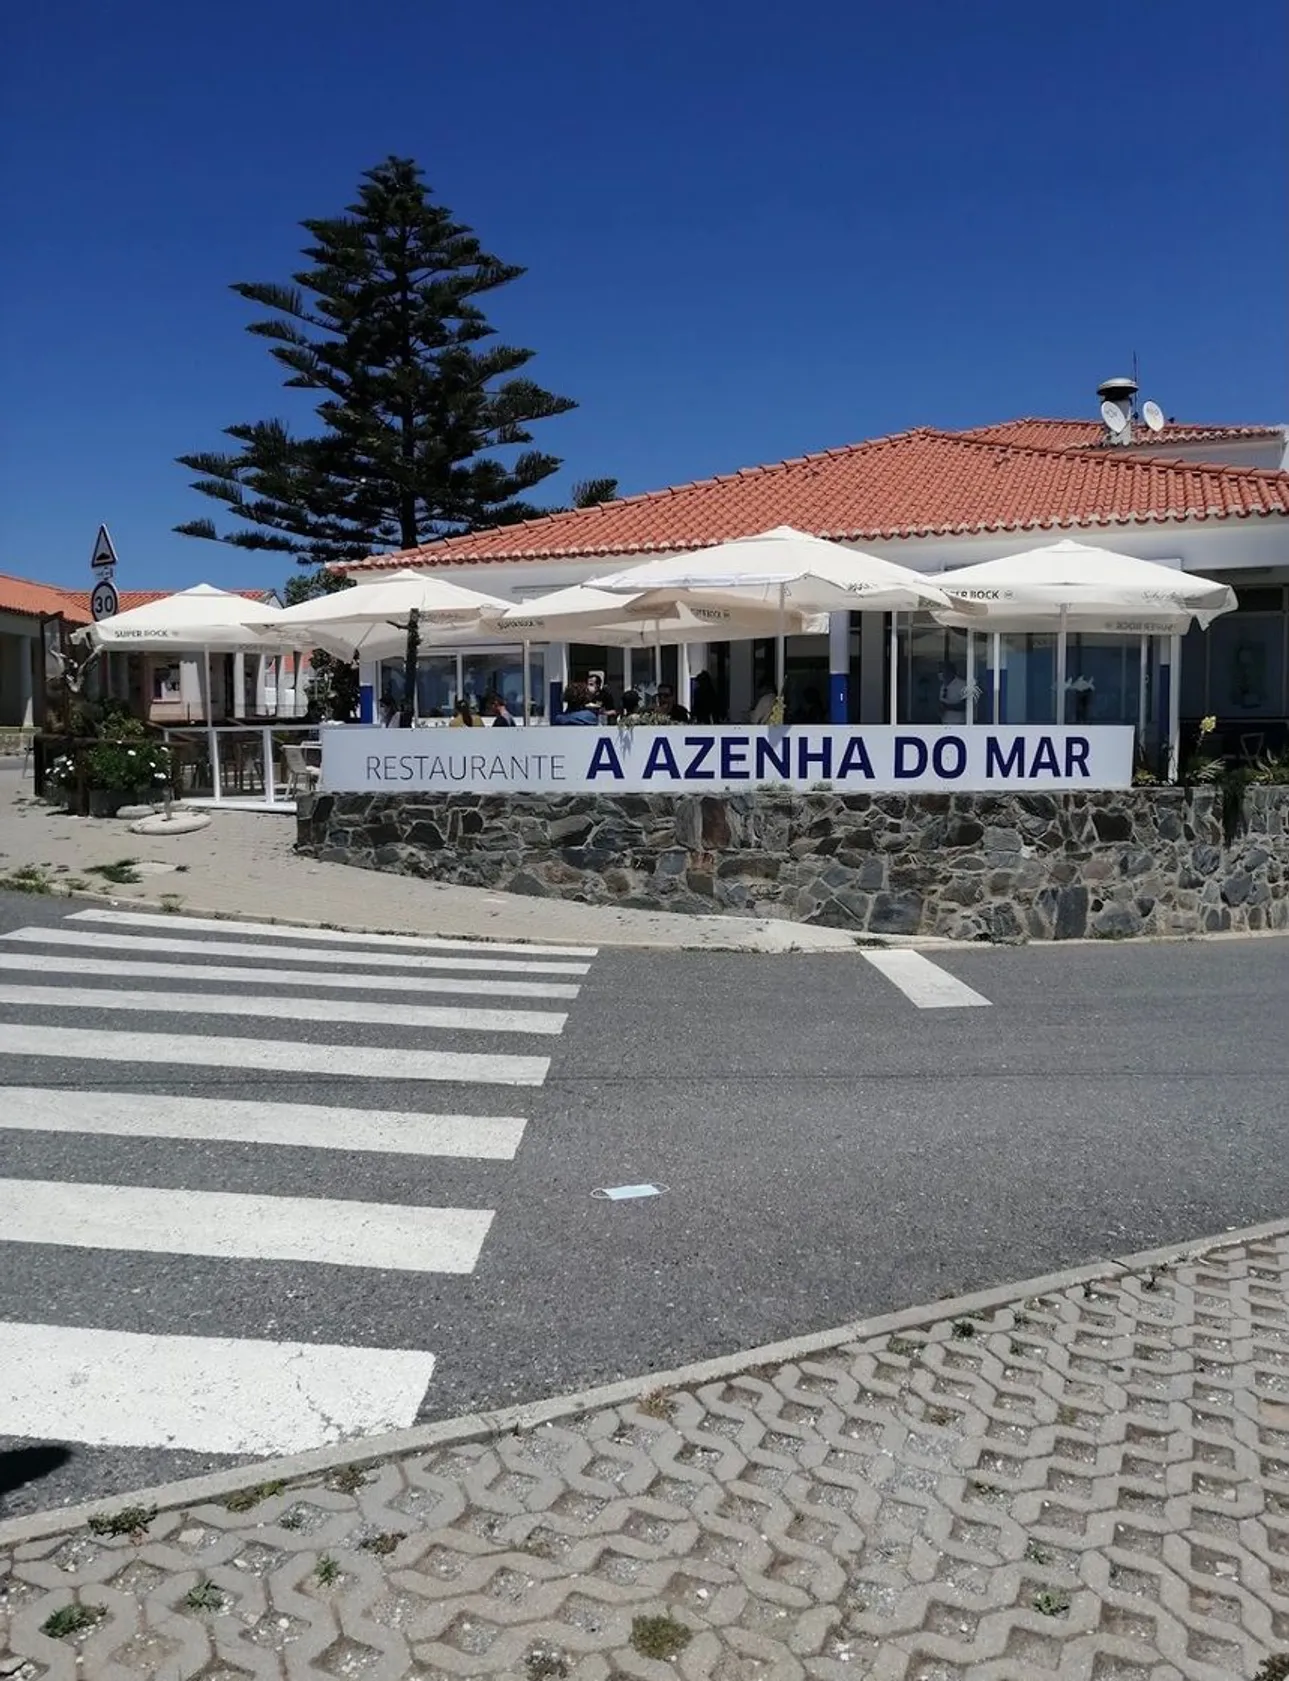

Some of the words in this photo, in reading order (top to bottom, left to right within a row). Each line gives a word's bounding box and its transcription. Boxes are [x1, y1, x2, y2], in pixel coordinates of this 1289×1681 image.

[970, 590, 1000, 600] BOCK
[95, 595, 114, 613] 30
[114, 629, 142, 639] SUPER
[366, 755, 566, 781] RESTAURANTE
[585, 736, 625, 780] A
[641, 736, 876, 780] AZENHA
[893, 735, 968, 780] DO
[985, 735, 1091, 779] MAR
